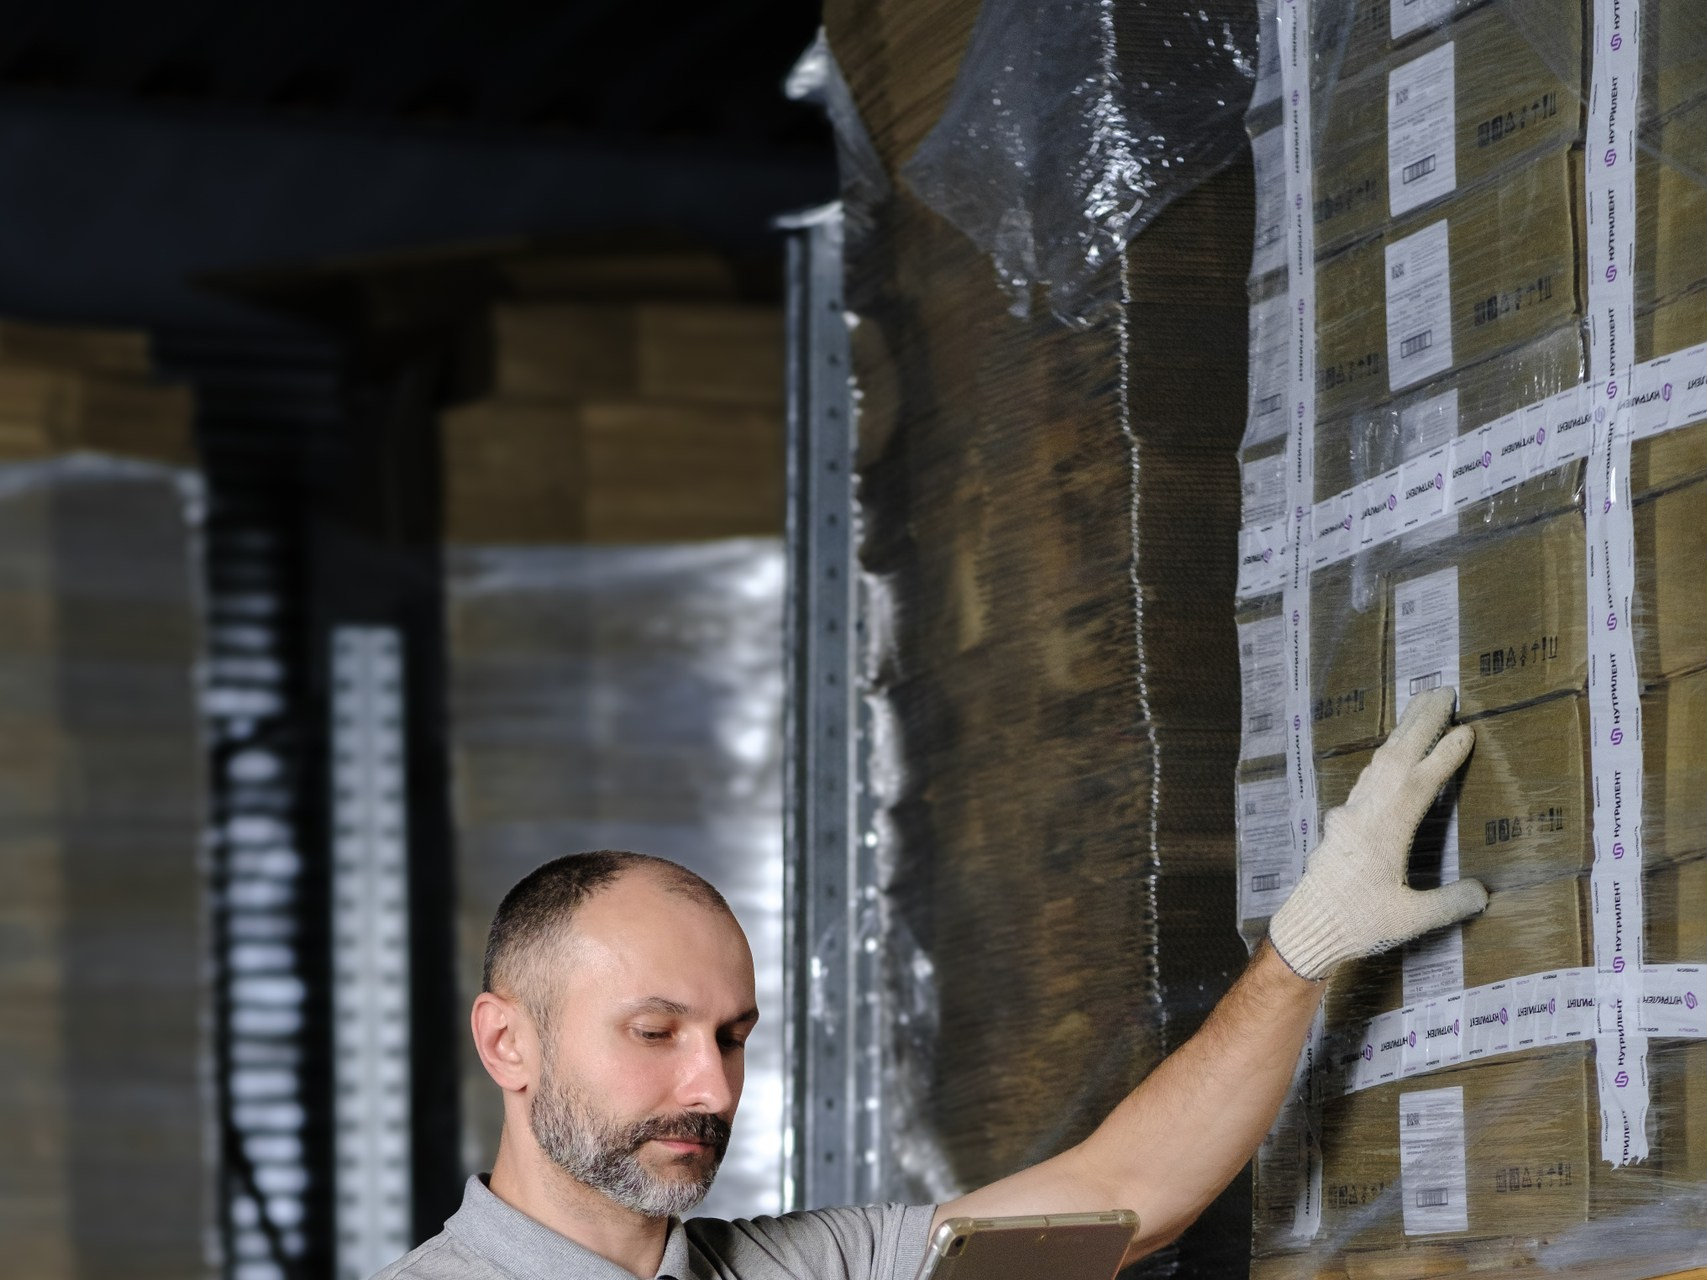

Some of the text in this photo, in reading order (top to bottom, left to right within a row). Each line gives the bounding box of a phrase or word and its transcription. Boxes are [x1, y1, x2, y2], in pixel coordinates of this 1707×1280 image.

[1608, 76, 1618, 145] НУТРИЛЕНТ
[1604, 539, 1613, 609] НУТРИЛЕНТ
[1610, 652, 1620, 724] НУТРИЛЕНТ
[1614, 770, 1622, 838] НУТРИЛЕНТ
[1614, 880, 1622, 951] НУТРИЛЕНТ
[1566, 997, 1595, 1009] РИЛЕНТ
[1616, 998, 1625, 1066] НУТРИЛЕНТ
